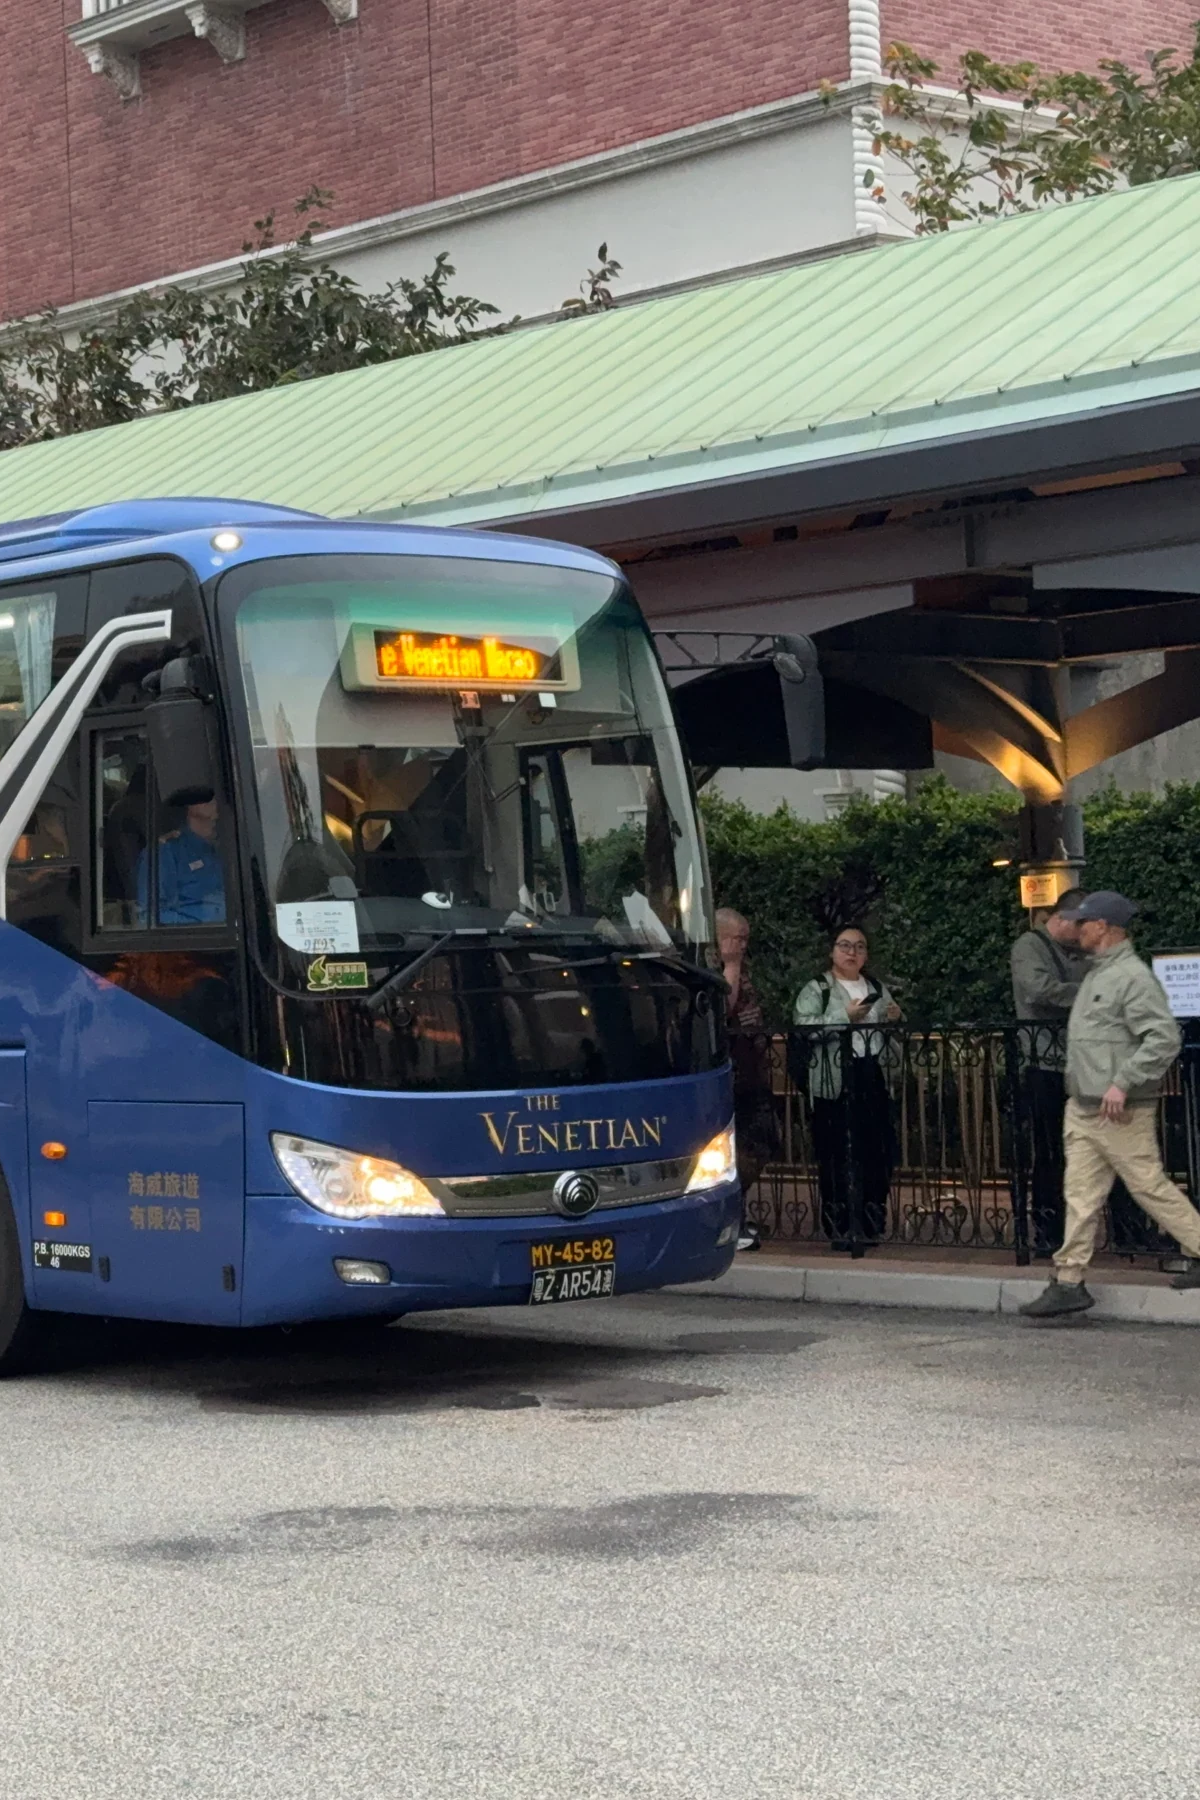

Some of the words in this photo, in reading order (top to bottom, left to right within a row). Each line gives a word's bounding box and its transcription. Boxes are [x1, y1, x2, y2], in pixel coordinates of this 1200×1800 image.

[523, 1094, 561, 1112] THE
[128, 1204, 201, 1233] 有限公司
[50, 1243, 91, 1259] 16000KGS
[531, 1238, 614, 1268] MY-45-82
[50, 1255, 60, 1269] 46
